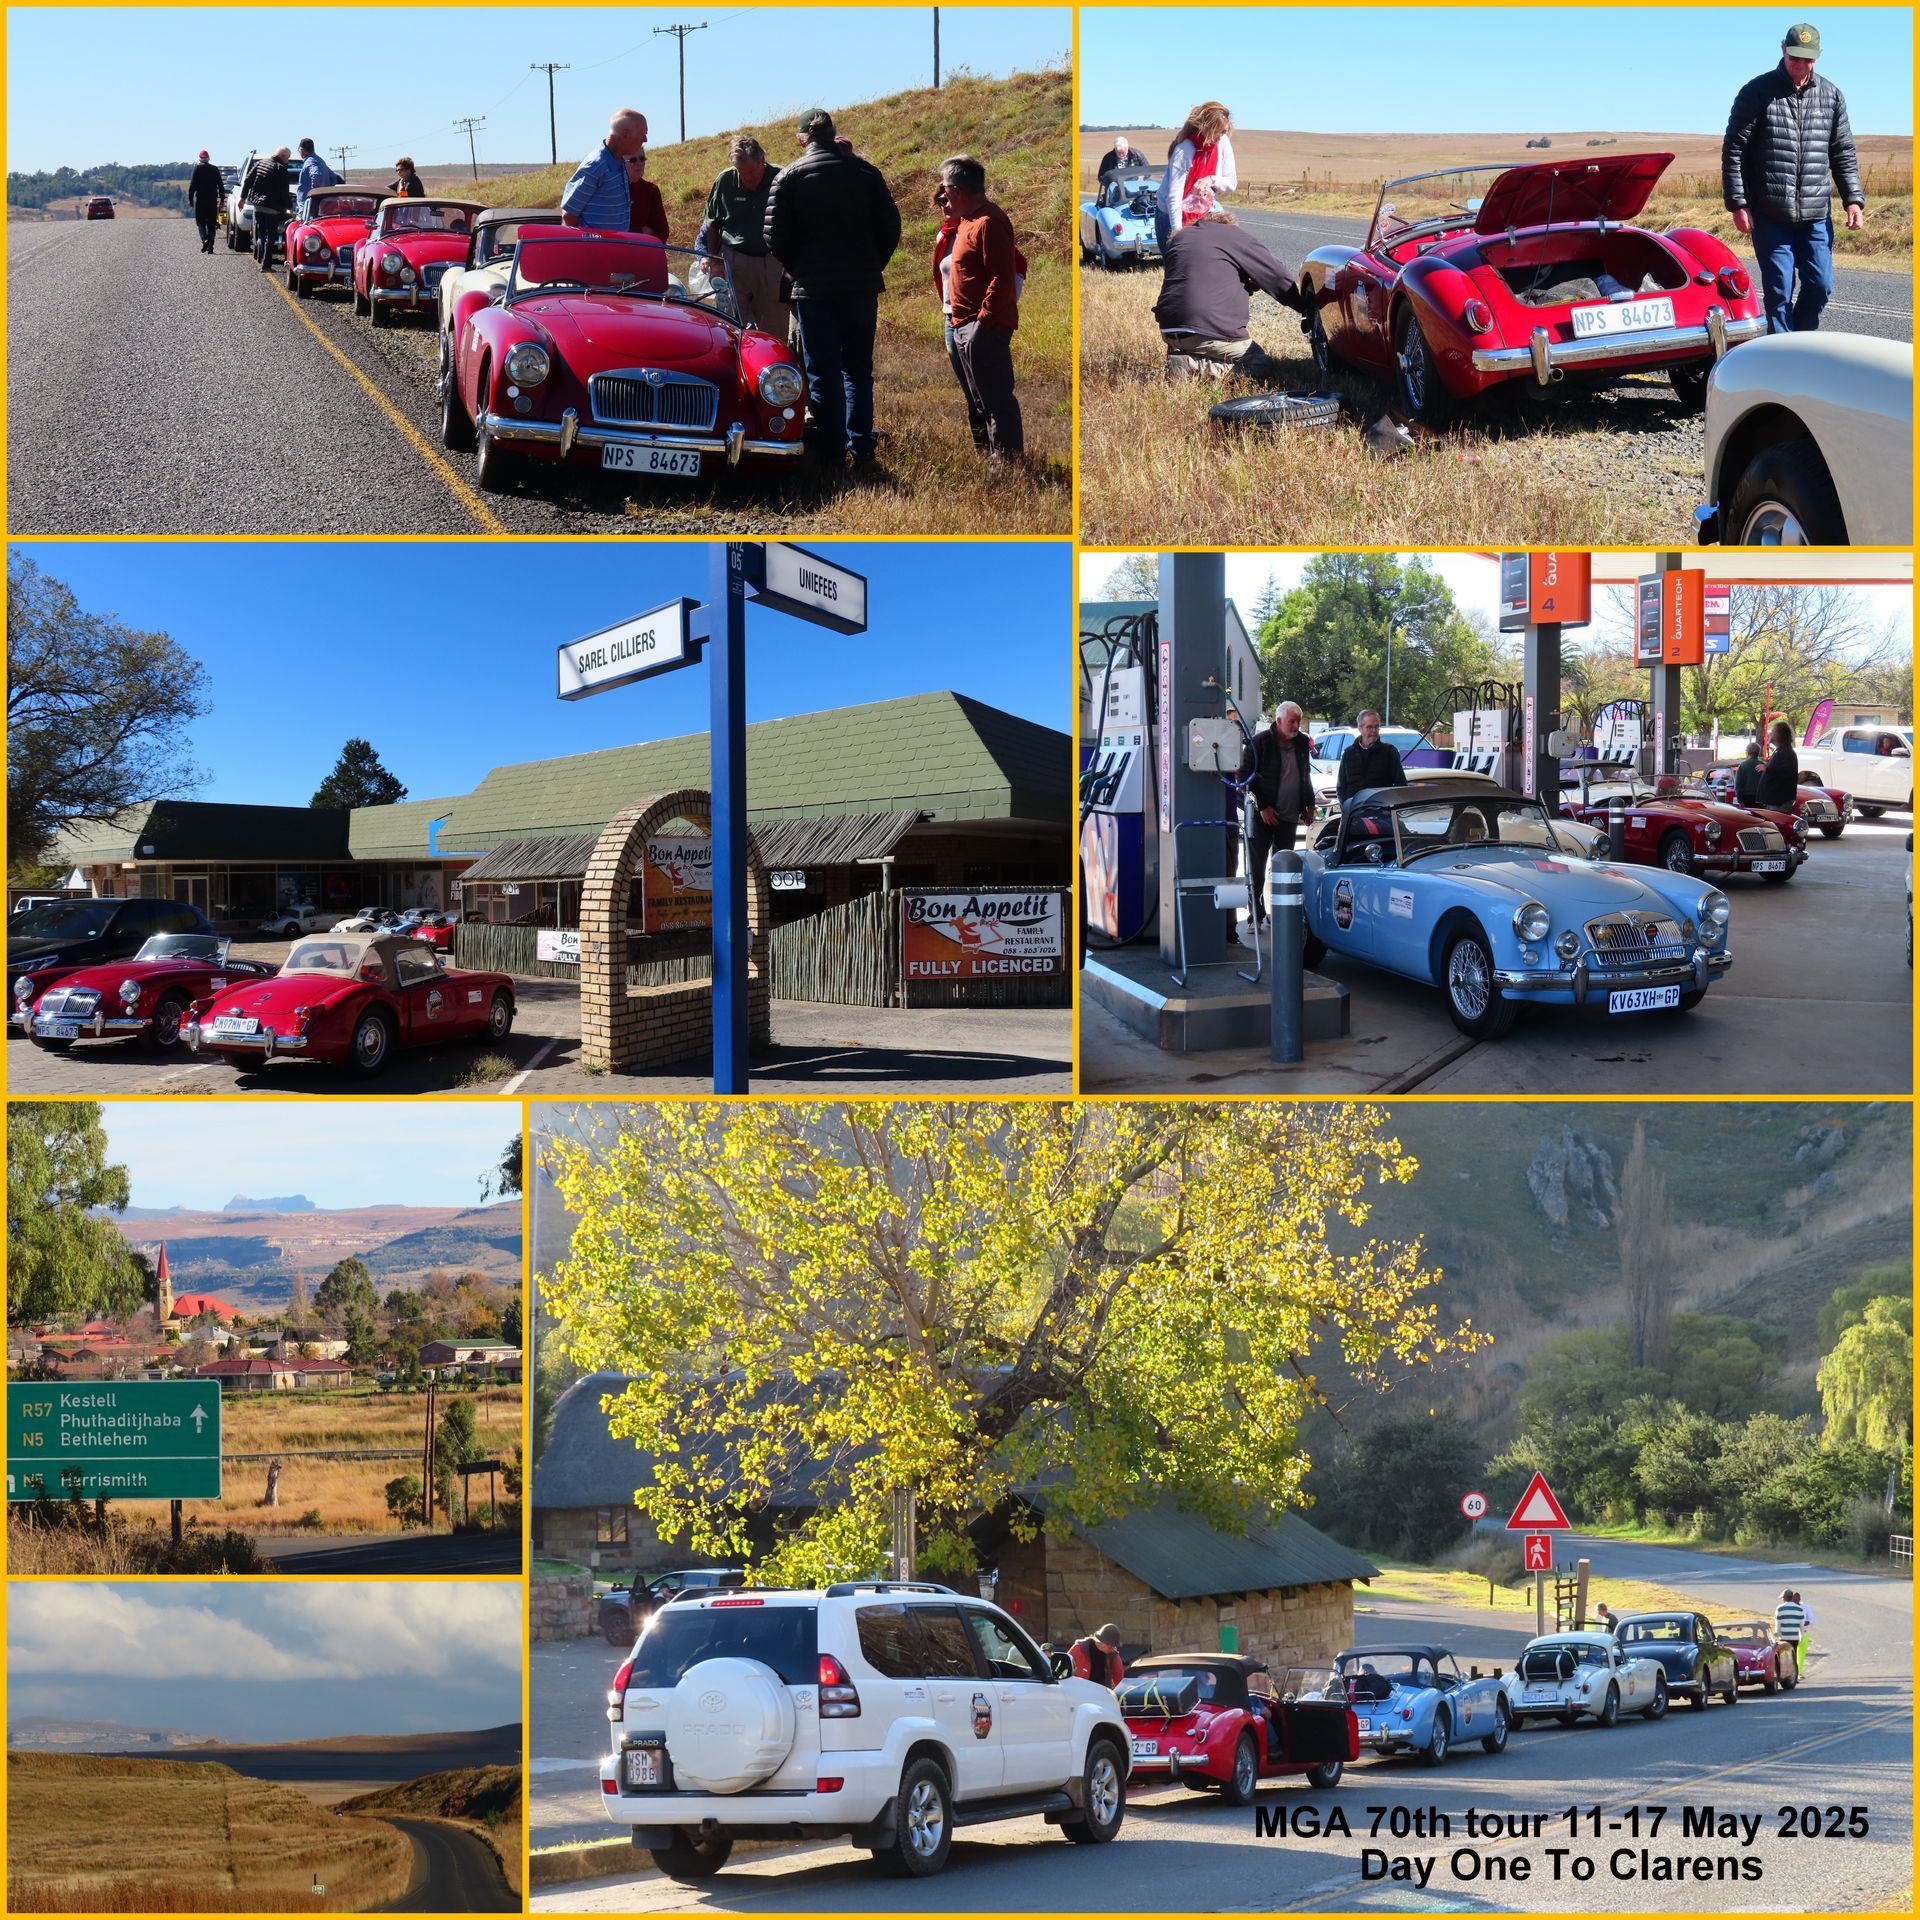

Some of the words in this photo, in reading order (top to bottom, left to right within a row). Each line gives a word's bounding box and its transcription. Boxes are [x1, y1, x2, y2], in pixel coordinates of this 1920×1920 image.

[1575, 311, 1606, 332] NPS
[1621, 303, 1672, 326] 84673
[604, 446, 634, 467] NPS
[649, 451, 699, 472] 84673
[731, 550, 742, 571] 05
[799, 567, 838, 601] UNIEFEES
[1542, 597, 1555, 611] 4
[1675, 578, 1683, 640] QUARTECH
[578, 648, 608, 674] SAREL
[610, 629, 656, 663] CILLIERS
[1671, 647, 1680, 656] 2
[648, 844, 673, 863] Bon
[674, 845, 712, 864] Appeti
[1752, 862, 1763, 870] NPS
[1768, 861, 1785, 870] 84673
[908, 897, 956, 922] Bon
[962, 895, 1049, 919] Appetit
[1016, 927, 1044, 936] FAMILY
[561, 933, 578, 945] Bon
[1004, 936, 1055, 946] RESTAURANT
[556, 953, 577, 961] FULLY
[909, 960, 962, 976] FULLY
[971, 958, 1054, 975] LICENCED
[1611, 990, 1657, 1011] KV63XH
[1664, 988, 1679, 1004] GP
[37, 1025, 50, 1036] NPS
[56, 1026, 78, 1037] 84673
[246, 1020, 257, 1031] GP
[22, 1403, 53, 1418] R57
[60, 1393, 117, 1408] Kestell
[60, 1413, 181, 1431] Phuthaditjhaba
[23, 1432, 44, 1446] N5
[61, 1432, 148, 1446] Bethlehem
[1467, 1500, 1481, 1511] 60
[682, 1724, 745, 1735] PRADO
[1145, 1742, 1157, 1753] GP
[628, 1752, 648, 1767] WSM
